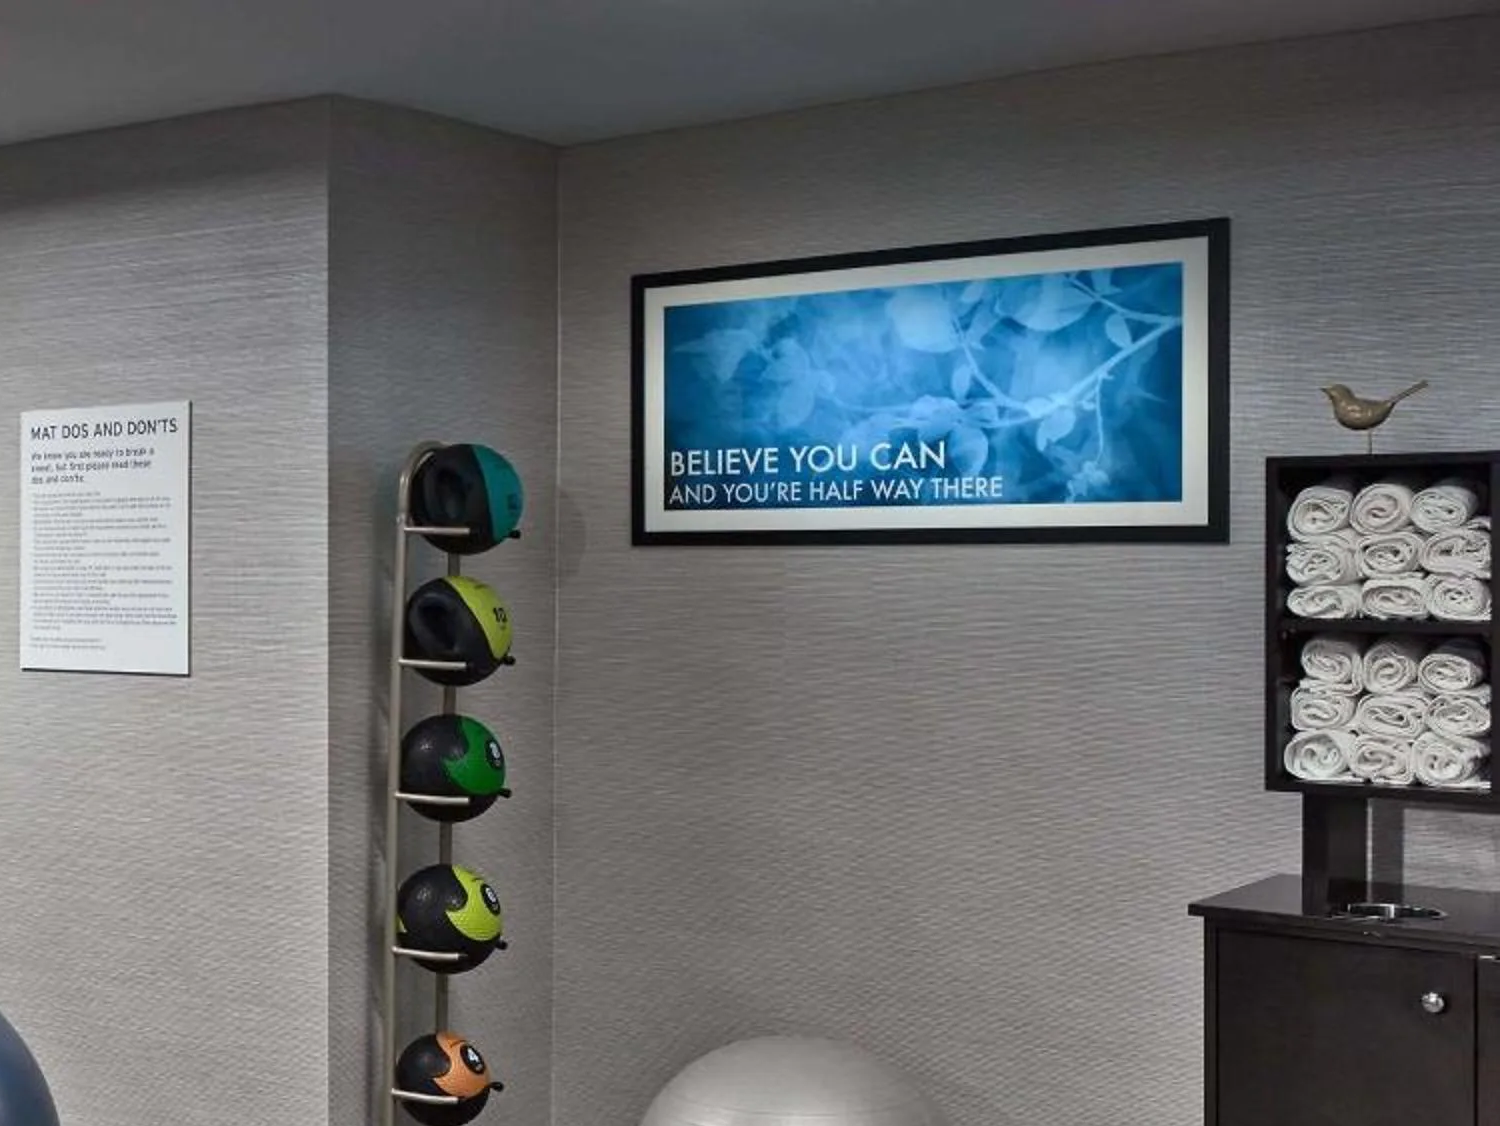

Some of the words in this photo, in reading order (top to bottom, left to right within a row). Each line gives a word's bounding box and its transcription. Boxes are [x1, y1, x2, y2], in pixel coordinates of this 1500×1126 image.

[31, 425, 57, 440] MAT
[61, 423, 89, 439] DOS
[93, 421, 123, 437] AND
[127, 417, 178, 435] DON'TS
[670, 447, 779, 476] BELIEVE
[790, 444, 857, 473] YOU
[870, 440, 946, 470] CAN
[669, 482, 717, 504] AND
[723, 480, 802, 503] YOU'RE
[809, 479, 864, 501] HALF
[870, 478, 923, 500] WAY
[931, 476, 1003, 498] THERE
